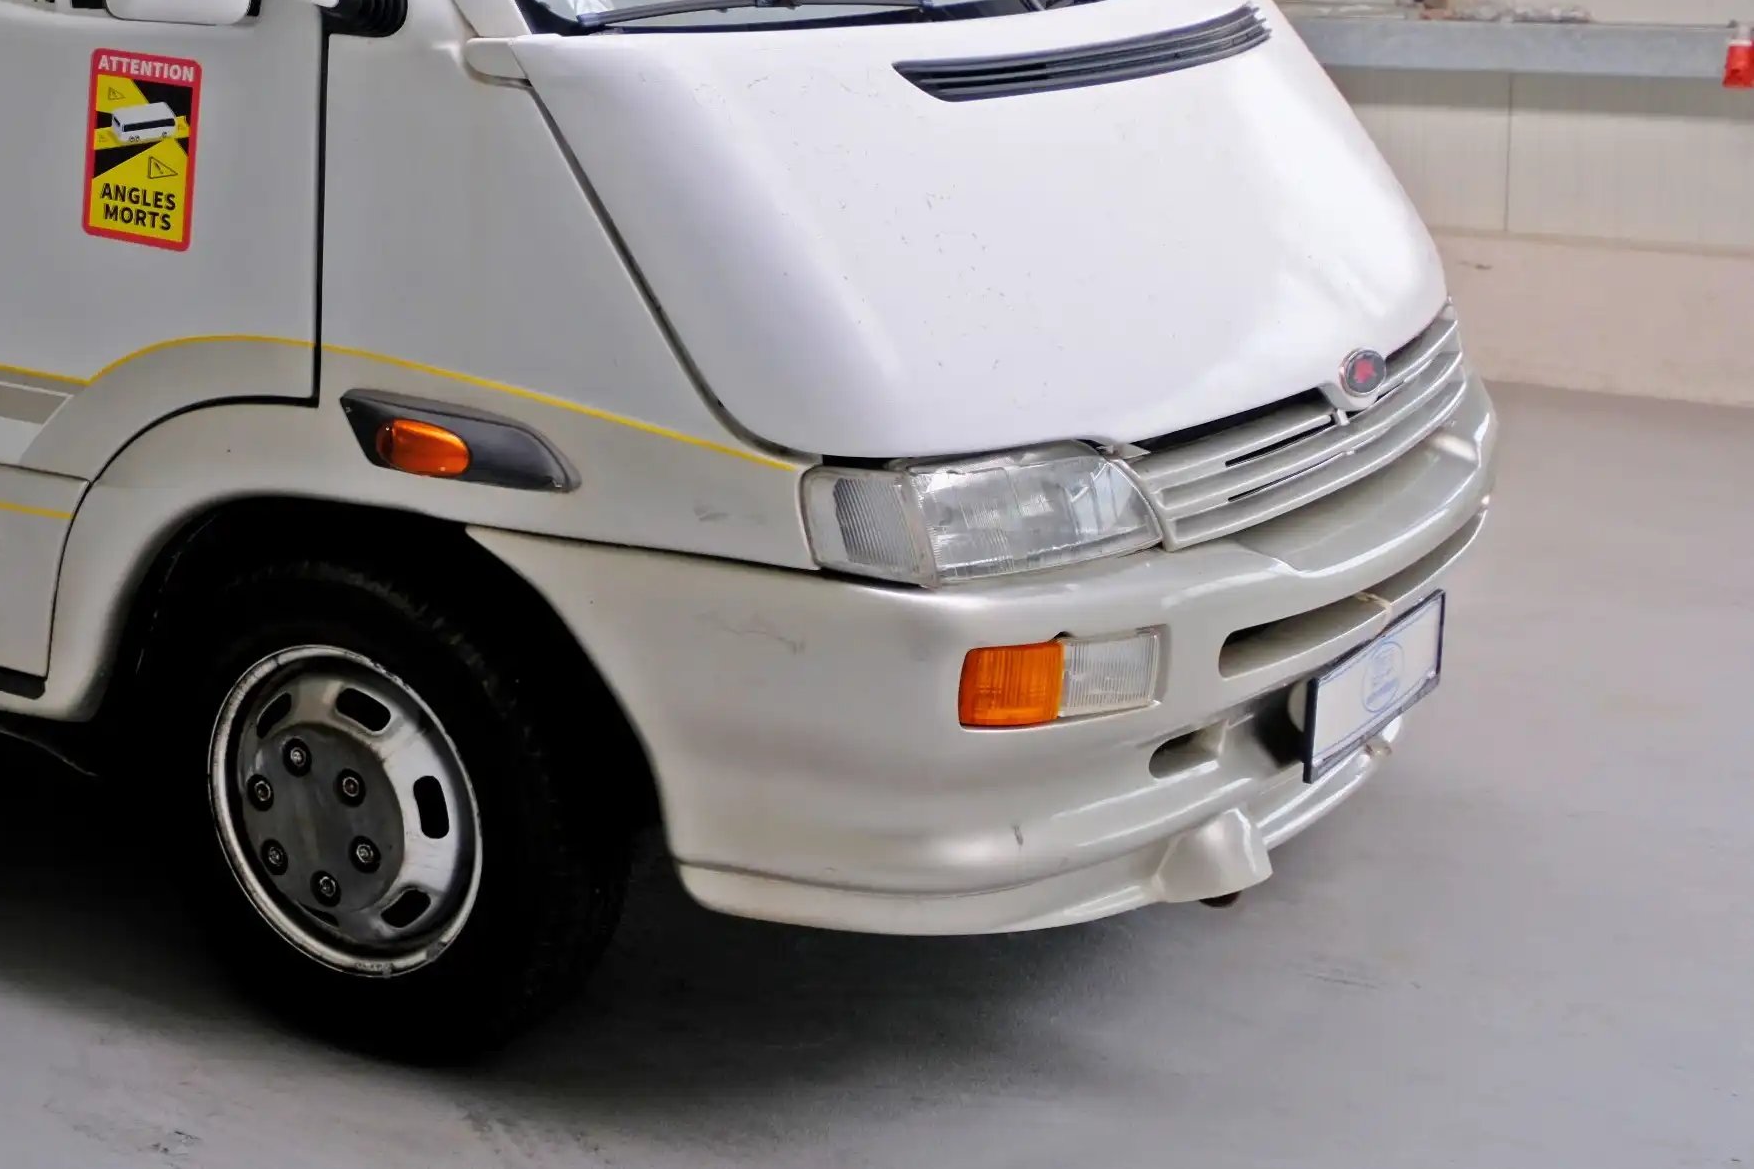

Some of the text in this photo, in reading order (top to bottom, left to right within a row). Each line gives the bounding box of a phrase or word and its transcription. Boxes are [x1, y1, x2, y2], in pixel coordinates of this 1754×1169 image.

[98, 54, 195, 83] ATTENTION
[100, 182, 177, 211] ANGLES
[103, 202, 172, 231] MORTS
